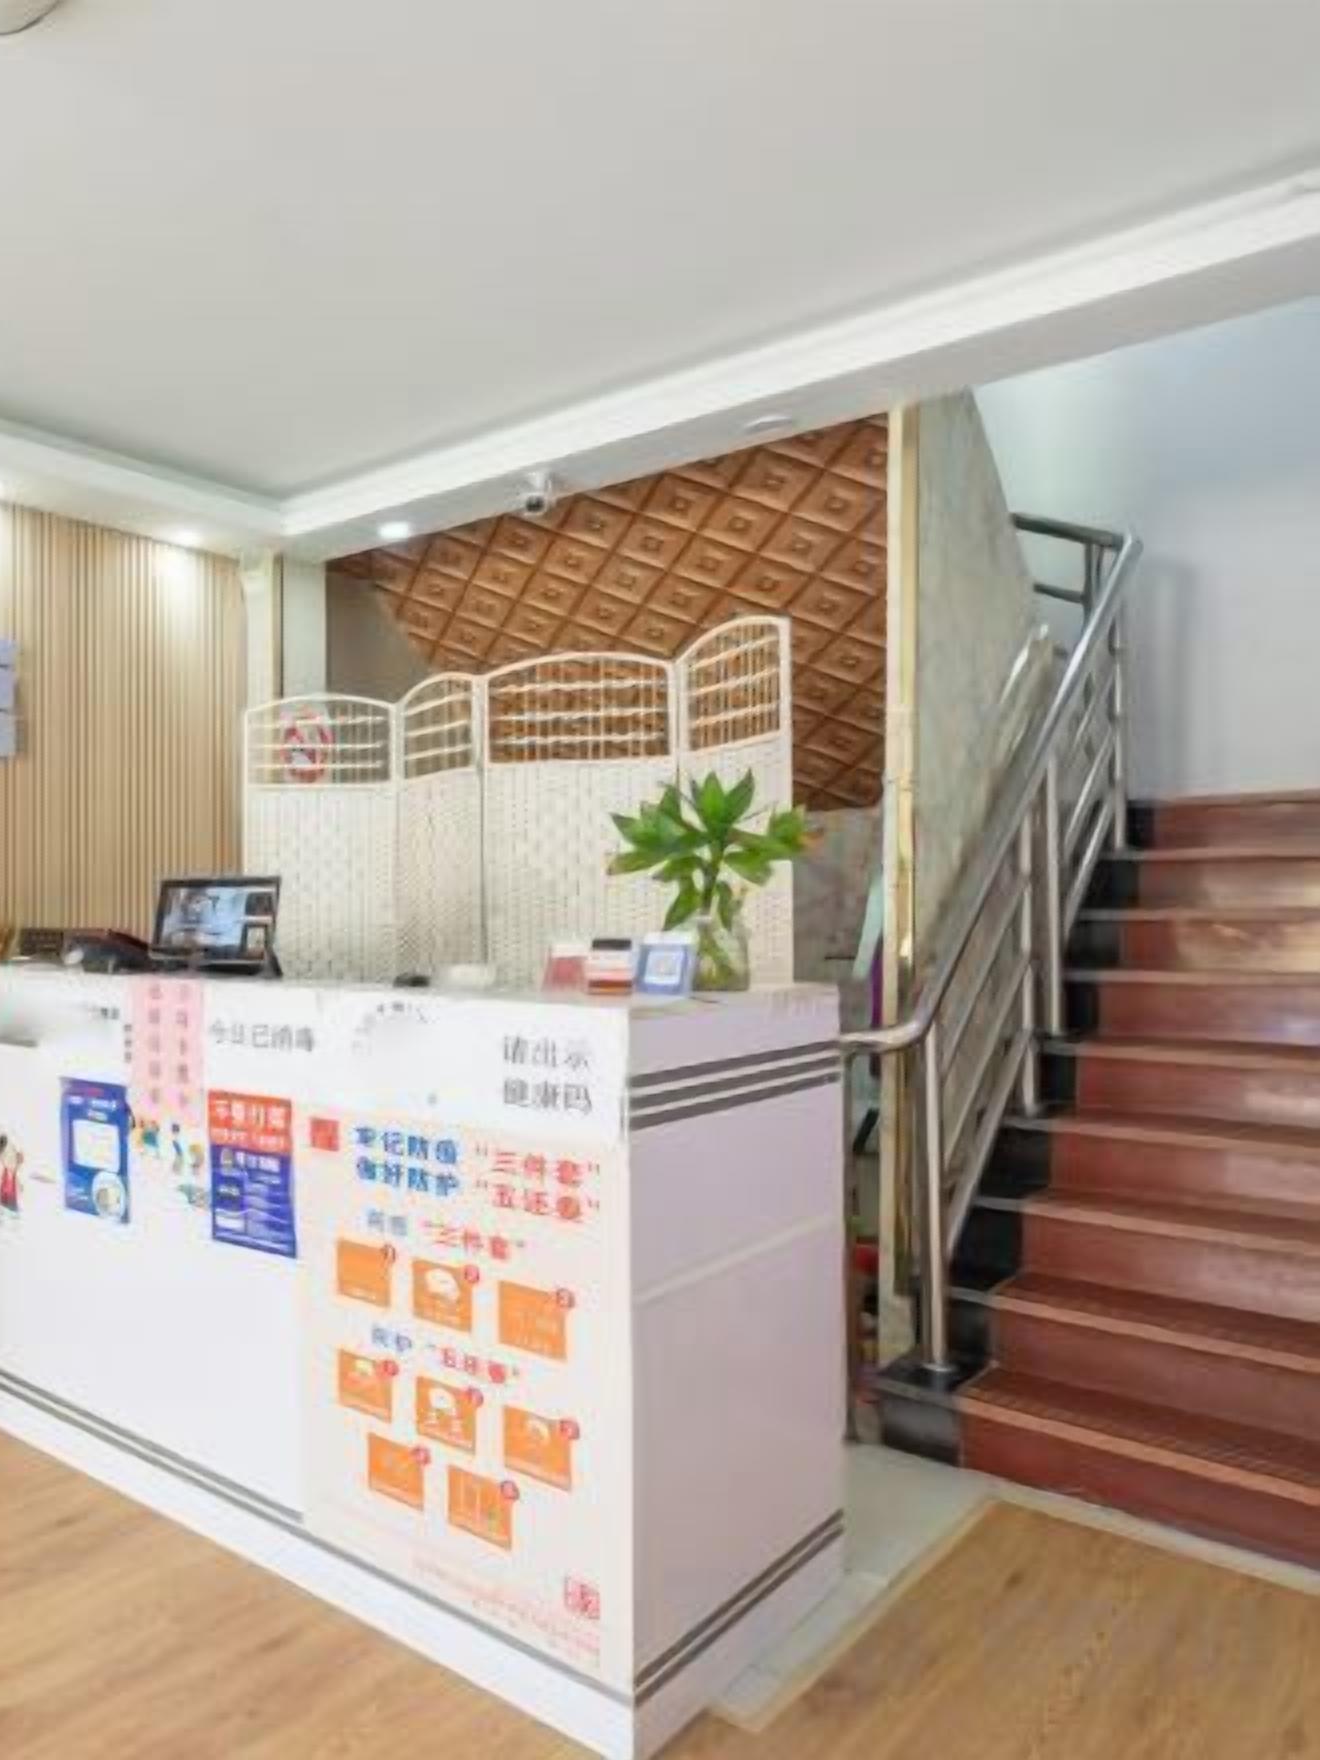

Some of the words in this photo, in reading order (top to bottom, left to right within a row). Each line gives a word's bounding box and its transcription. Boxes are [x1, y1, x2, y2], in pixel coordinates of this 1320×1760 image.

[503, 1034, 591, 1071] 请出示
[503, 1078, 592, 1111] 健康码
